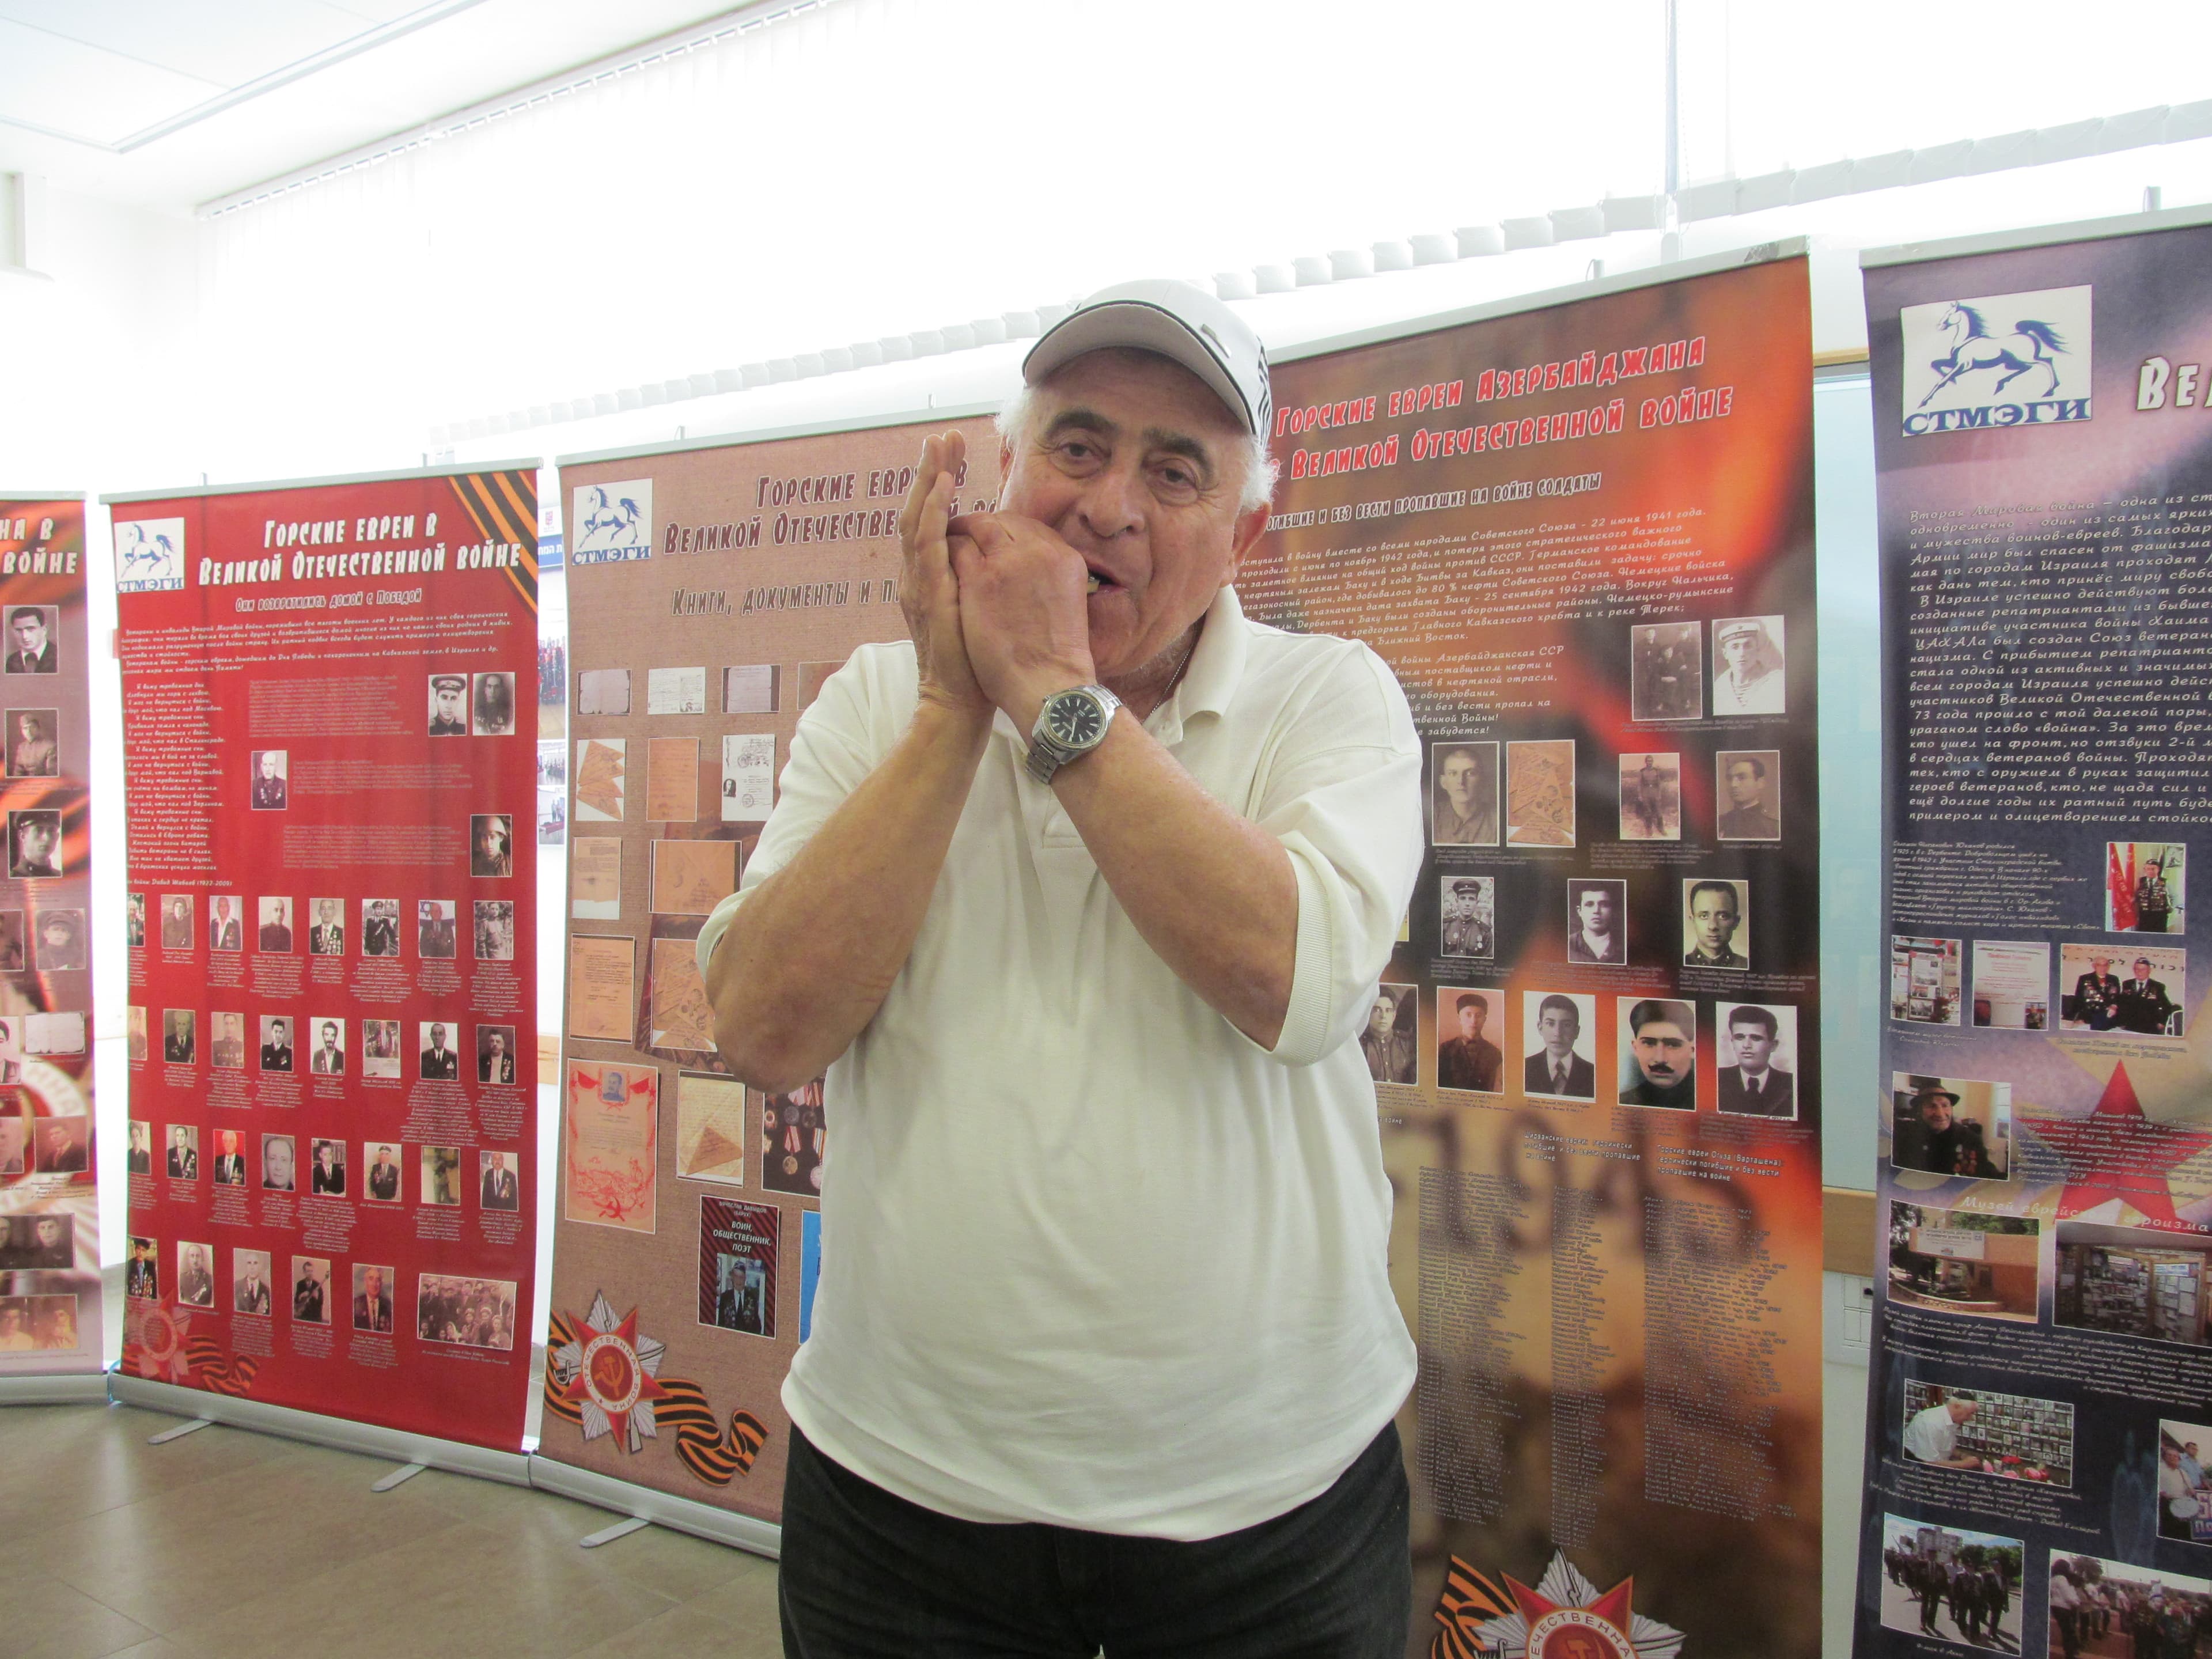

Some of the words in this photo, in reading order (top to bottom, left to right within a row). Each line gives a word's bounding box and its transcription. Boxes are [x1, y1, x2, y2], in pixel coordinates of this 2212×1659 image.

[1903, 398, 2091, 435] СТМЭГИ
[40, 518, 54, 540] В
[772, 502, 959, 546] ОТЕЧЕСТВЕ
[1267, 511, 1314, 530] ОГИБШИЕ
[1325, 548, 1362, 556] вместе
[1381, 542, 1410, 550] всеми
[1414, 535, 1466, 547] народами
[1471, 528, 1534, 540] Советского
[1539, 524, 1575, 532] Союза
[1591, 518, 1605, 527] 22
[1611, 517, 1640, 525] июня
[1646, 512, 1671, 521] 1941
[1677, 507, 1705, 518] года.
[1923, 535, 1999, 549] мужества
[2008, 528, 2123, 542] воинов-евреев.
[571, 547, 650, 565] СТМЭГИ
[1910, 554, 1960, 565] Армии
[1968, 552, 1997, 560] мир
[2005, 548, 2032, 557] был
[2040, 547, 2093, 555] спасен
[2131, 541, 2210, 553] фашизма
[117, 577, 184, 593] СТМЭГИ
[1313, 607, 1362, 615] назначена
[1366, 603, 1391, 611] дата
[1396, 598, 1439, 608] захвата
[1445, 595, 1470, 604] Баку
[1484, 592, 1497, 601] 25
[1502, 588, 1553, 599] сентября
[1560, 585, 1585, 593] 1942
[1591, 582, 1620, 591] года.
[1626, 579, 1666, 590] Вокруг
[1672, 574, 1733, 584] Нальчика,
[1921, 595, 1929, 607] В
[1936, 595, 1998, 605] Израиле
[2006, 593, 2070, 603] успешно
[2078, 586, 2169, 599] действуют
[1911, 609, 1984, 620] созданные
[1992, 606, 2125, 618] репатриантами
[2158, 599, 2212, 610] бывше
[1378, 635, 1420, 645] Ближний
[1425, 633, 1468, 643] Восток.
[1436, 650, 1535, 664] Азербайджанская
[1540, 646, 1564, 655] ССР
[1425, 665, 1500, 675] поставщиком
[1447, 676, 1502, 687] нефтяной
[1507, 675, 1556, 684] отрасли,
[1421, 689, 1498, 700] оборудования.
[1435, 702, 1453, 710] без
[1458, 701, 1490, 710] вести
[1495, 702, 1532, 710] пропал
[1916, 711, 1930, 719] 73
[1937, 710, 1968, 719] года
[1975, 711, 2032, 721] прошло
[2055, 706, 2086, 717] той
[2093, 707, 2157, 717] далекой
[1462, 713, 1498, 724] Войны!
[1429, 726, 1488, 736] забудется!
[1910, 813, 1982, 821] примером
[2006, 811, 2140, 823] олицетворением
[732, 1221, 752, 1232] ВОИН,
[713, 1229, 771, 1246] ОБЩЕСТВЕННИК,
[732, 1244, 751, 1253] ПОЭТ
